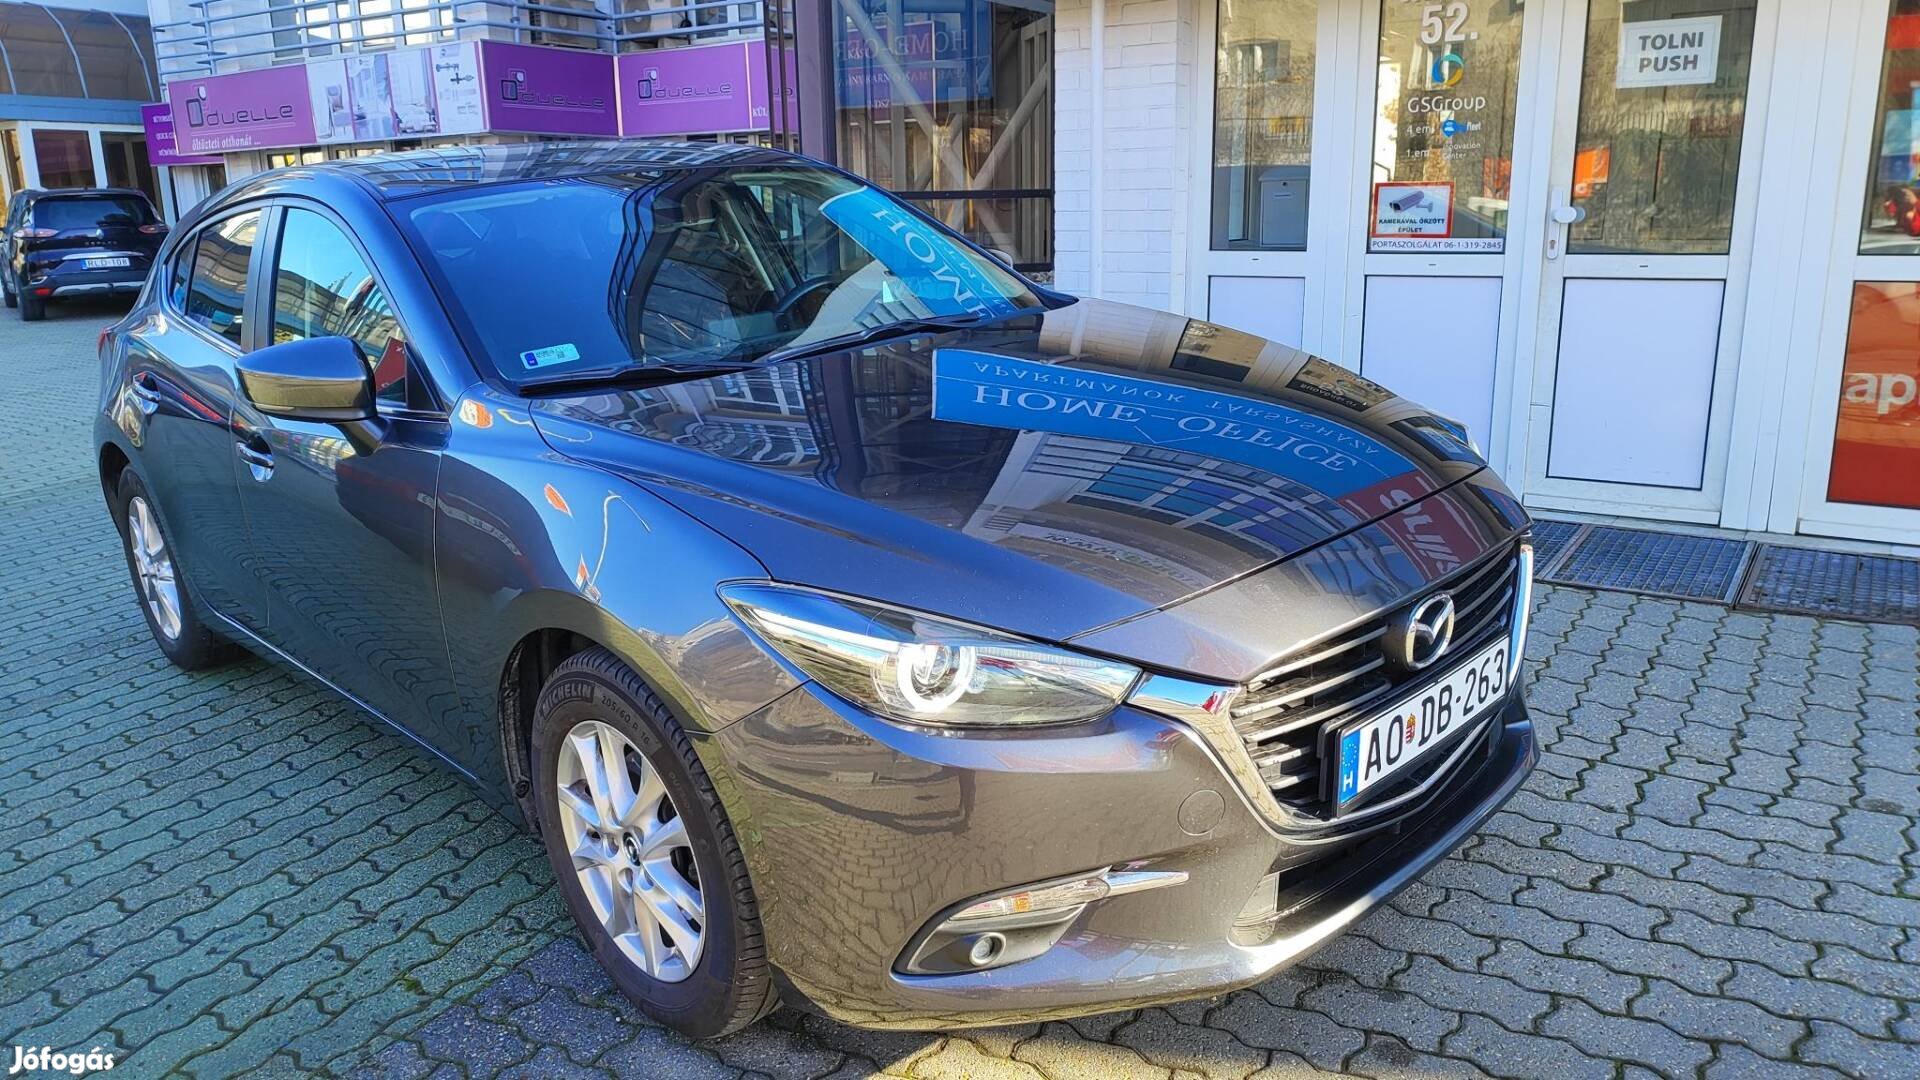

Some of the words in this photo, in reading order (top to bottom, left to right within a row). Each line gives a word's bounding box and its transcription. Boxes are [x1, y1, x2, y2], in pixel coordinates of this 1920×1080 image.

[1421, 2, 1478, 44] 52.
[1638, 31, 1704, 51] TOLNI
[1638, 54, 1699, 73] PUSH
[1407, 96, 1486, 113] GSGroup
[541, 681, 592, 717] MICHELIN
[1364, 714, 1404, 781] AO
[1343, 771, 1354, 792] H
